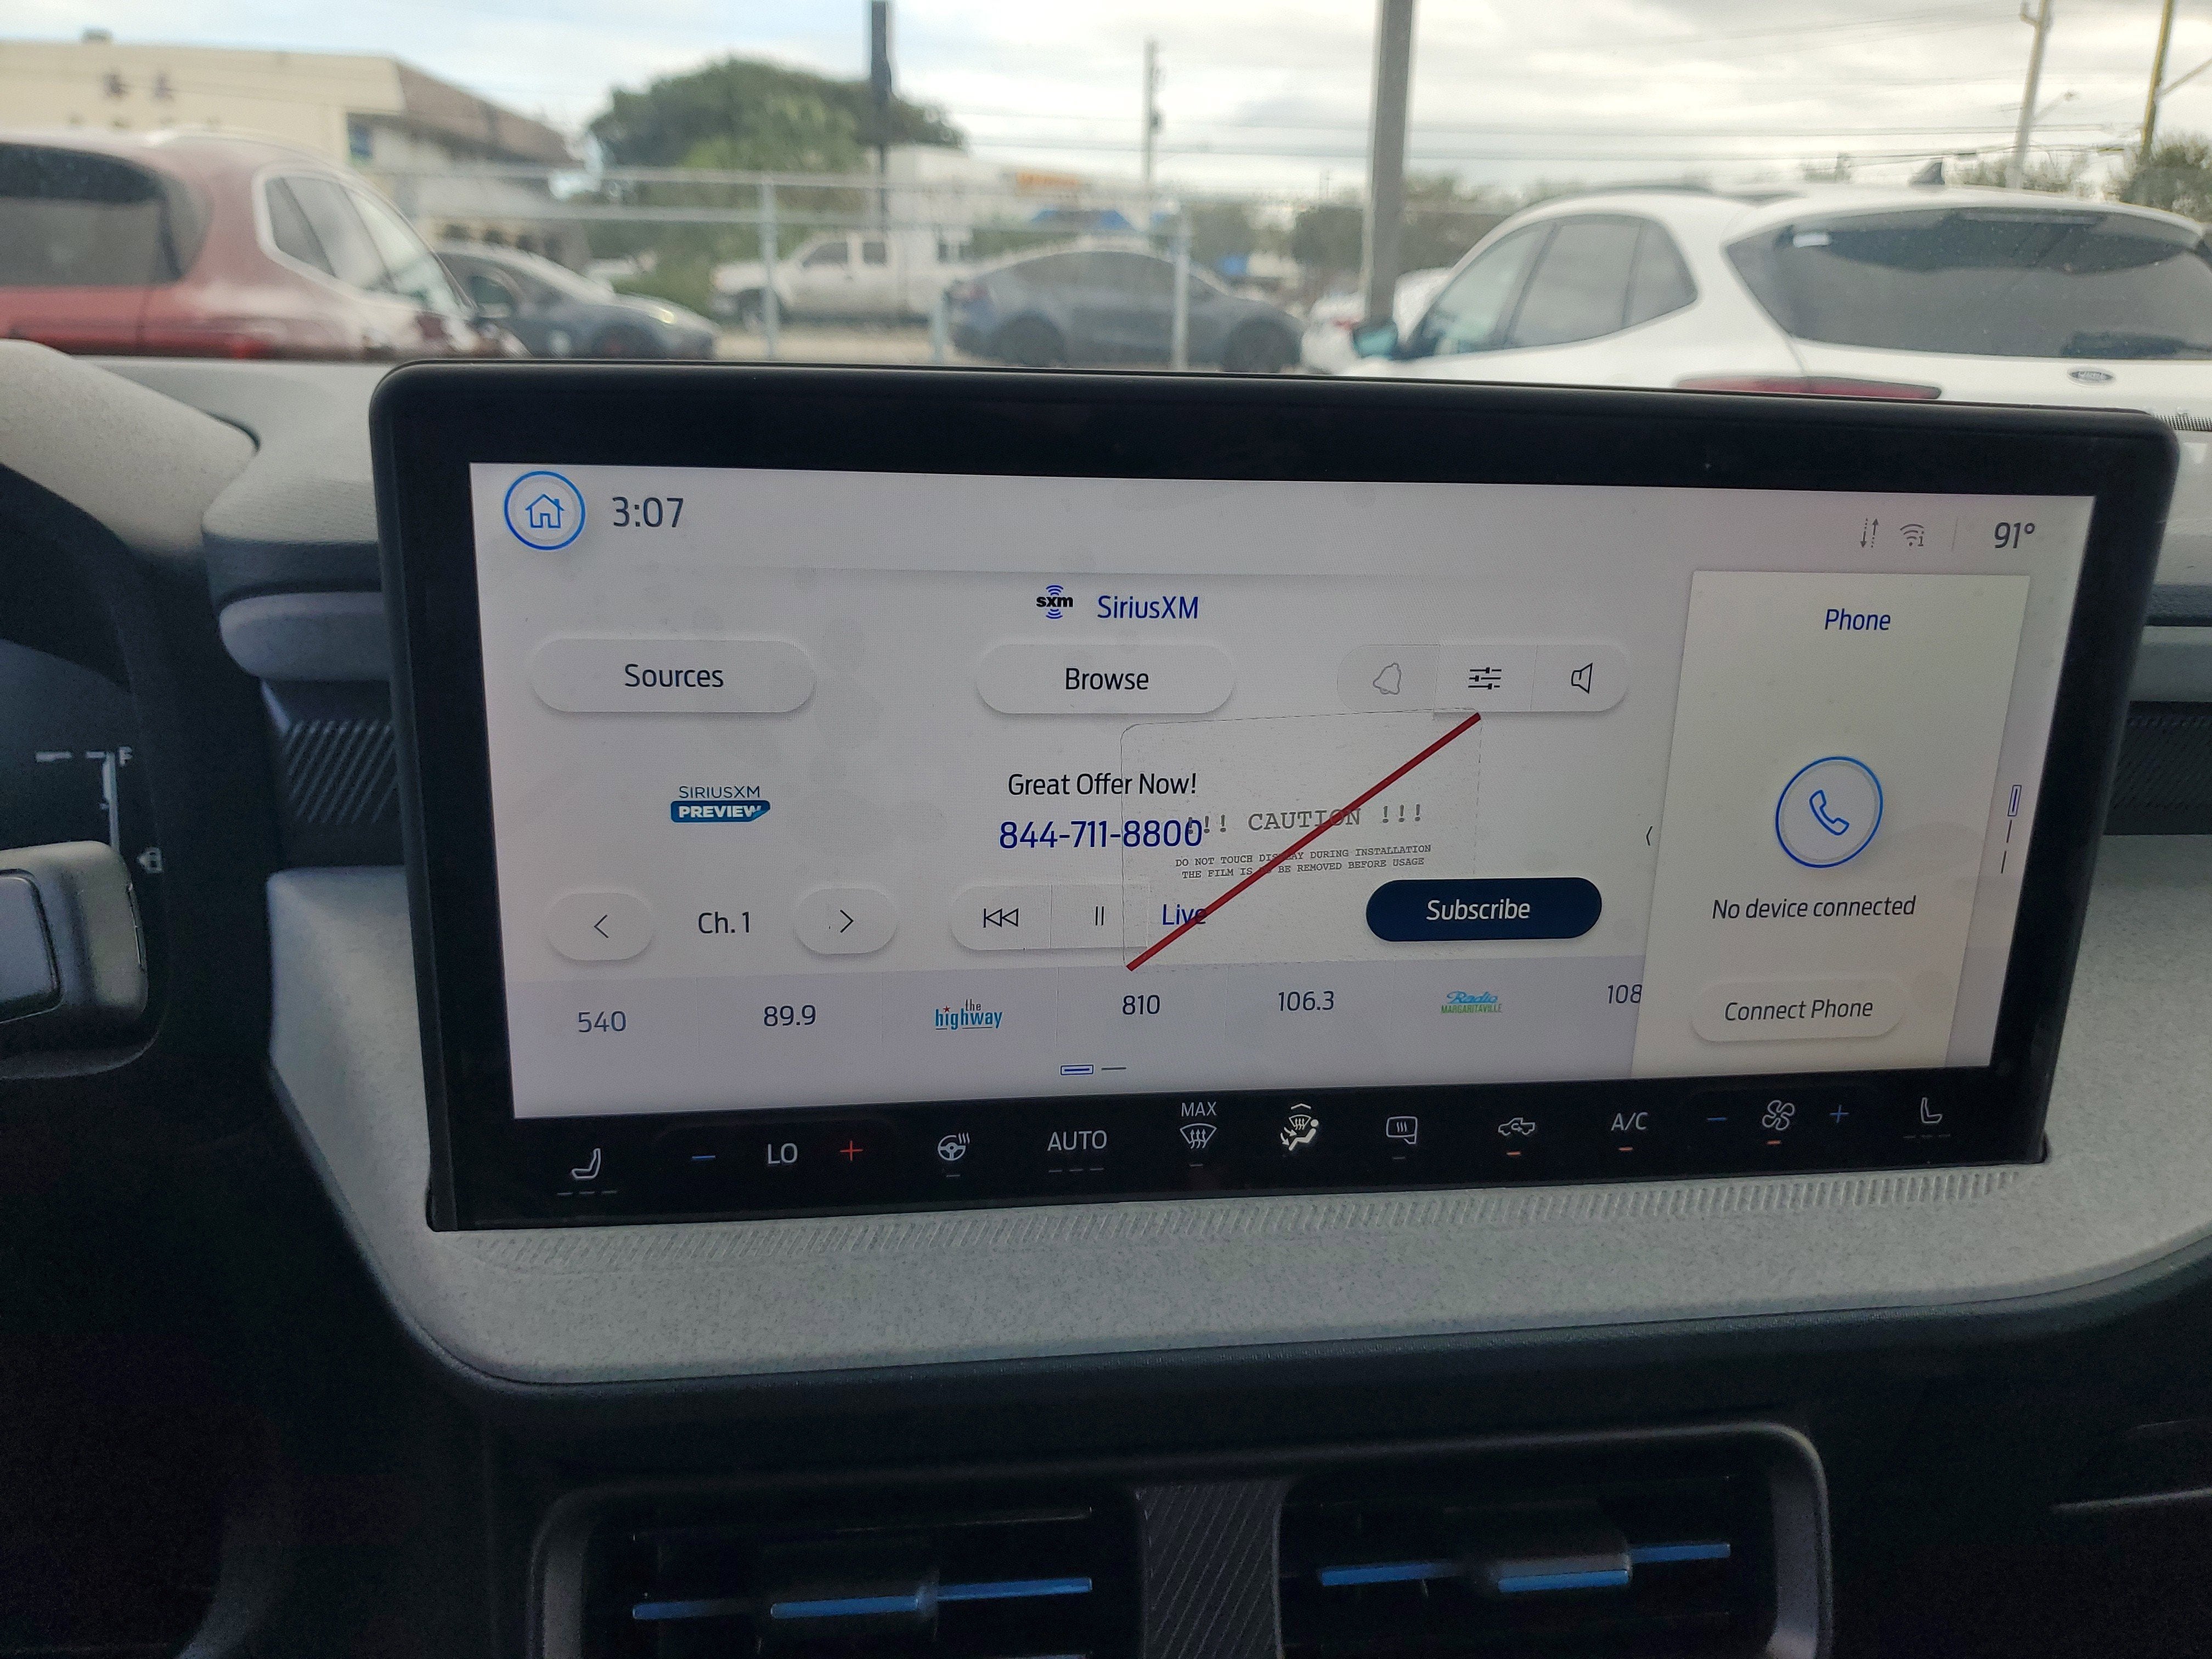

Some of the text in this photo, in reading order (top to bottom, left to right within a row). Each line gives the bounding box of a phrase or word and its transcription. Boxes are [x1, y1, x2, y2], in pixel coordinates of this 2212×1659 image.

[612, 496, 684, 528] 3:07
[1994, 522, 2035, 549] 91°
[1036, 596, 1074, 608] sxm
[1097, 595, 1198, 619] SiriusXM
[1825, 608, 1891, 631] Phone
[625, 663, 724, 687] Sources
[1065, 668, 1149, 690] Browse
[679, 786, 760, 799] SIRIUSXM
[1008, 772, 1196, 795] Great Offer Now!
[679, 805, 762, 819] PREVIEW
[1248, 808, 1361, 831] CAUTION
[1000, 820, 1203, 849] 844-711-8800
[1175, 859, 1189, 867] DO
[1194, 857, 1215, 866] NOT
[1220, 854, 1253, 864] TOUCH
[1310, 849, 1349, 859] DURING
[1355, 844, 1432, 856] INSTALLATION
[1182, 870, 1201, 879] THE
[1207, 868, 1234, 877] FILM
[1240, 867, 1253, 876] IS
[1277, 865, 1291, 873] BE
[1296, 862, 1342, 872] REMOVED
[1347, 859, 1387, 869] BEFORE
[1392, 857, 1425, 866] USAGE
[1163, 904, 1207, 925] Live
[1426, 898, 1531, 921] Subscribe
[1712, 895, 1916, 919] No device connected
[965, 998, 981, 1011] the
[1122, 995, 1160, 1015] 810
[1278, 990, 1334, 1011] 106.3
[1725, 998, 1873, 1021] Connect Phone
[578, 1011, 627, 1032] 540
[764, 1005, 816, 1026] 89.9
[935, 1007, 1003, 1030] highway
[1181, 1102, 1217, 1118] MAX
[1611, 1111, 1648, 1132] A/C
[1047, 1130, 1108, 1152] AUTO
[768, 1143, 798, 1165] LO
